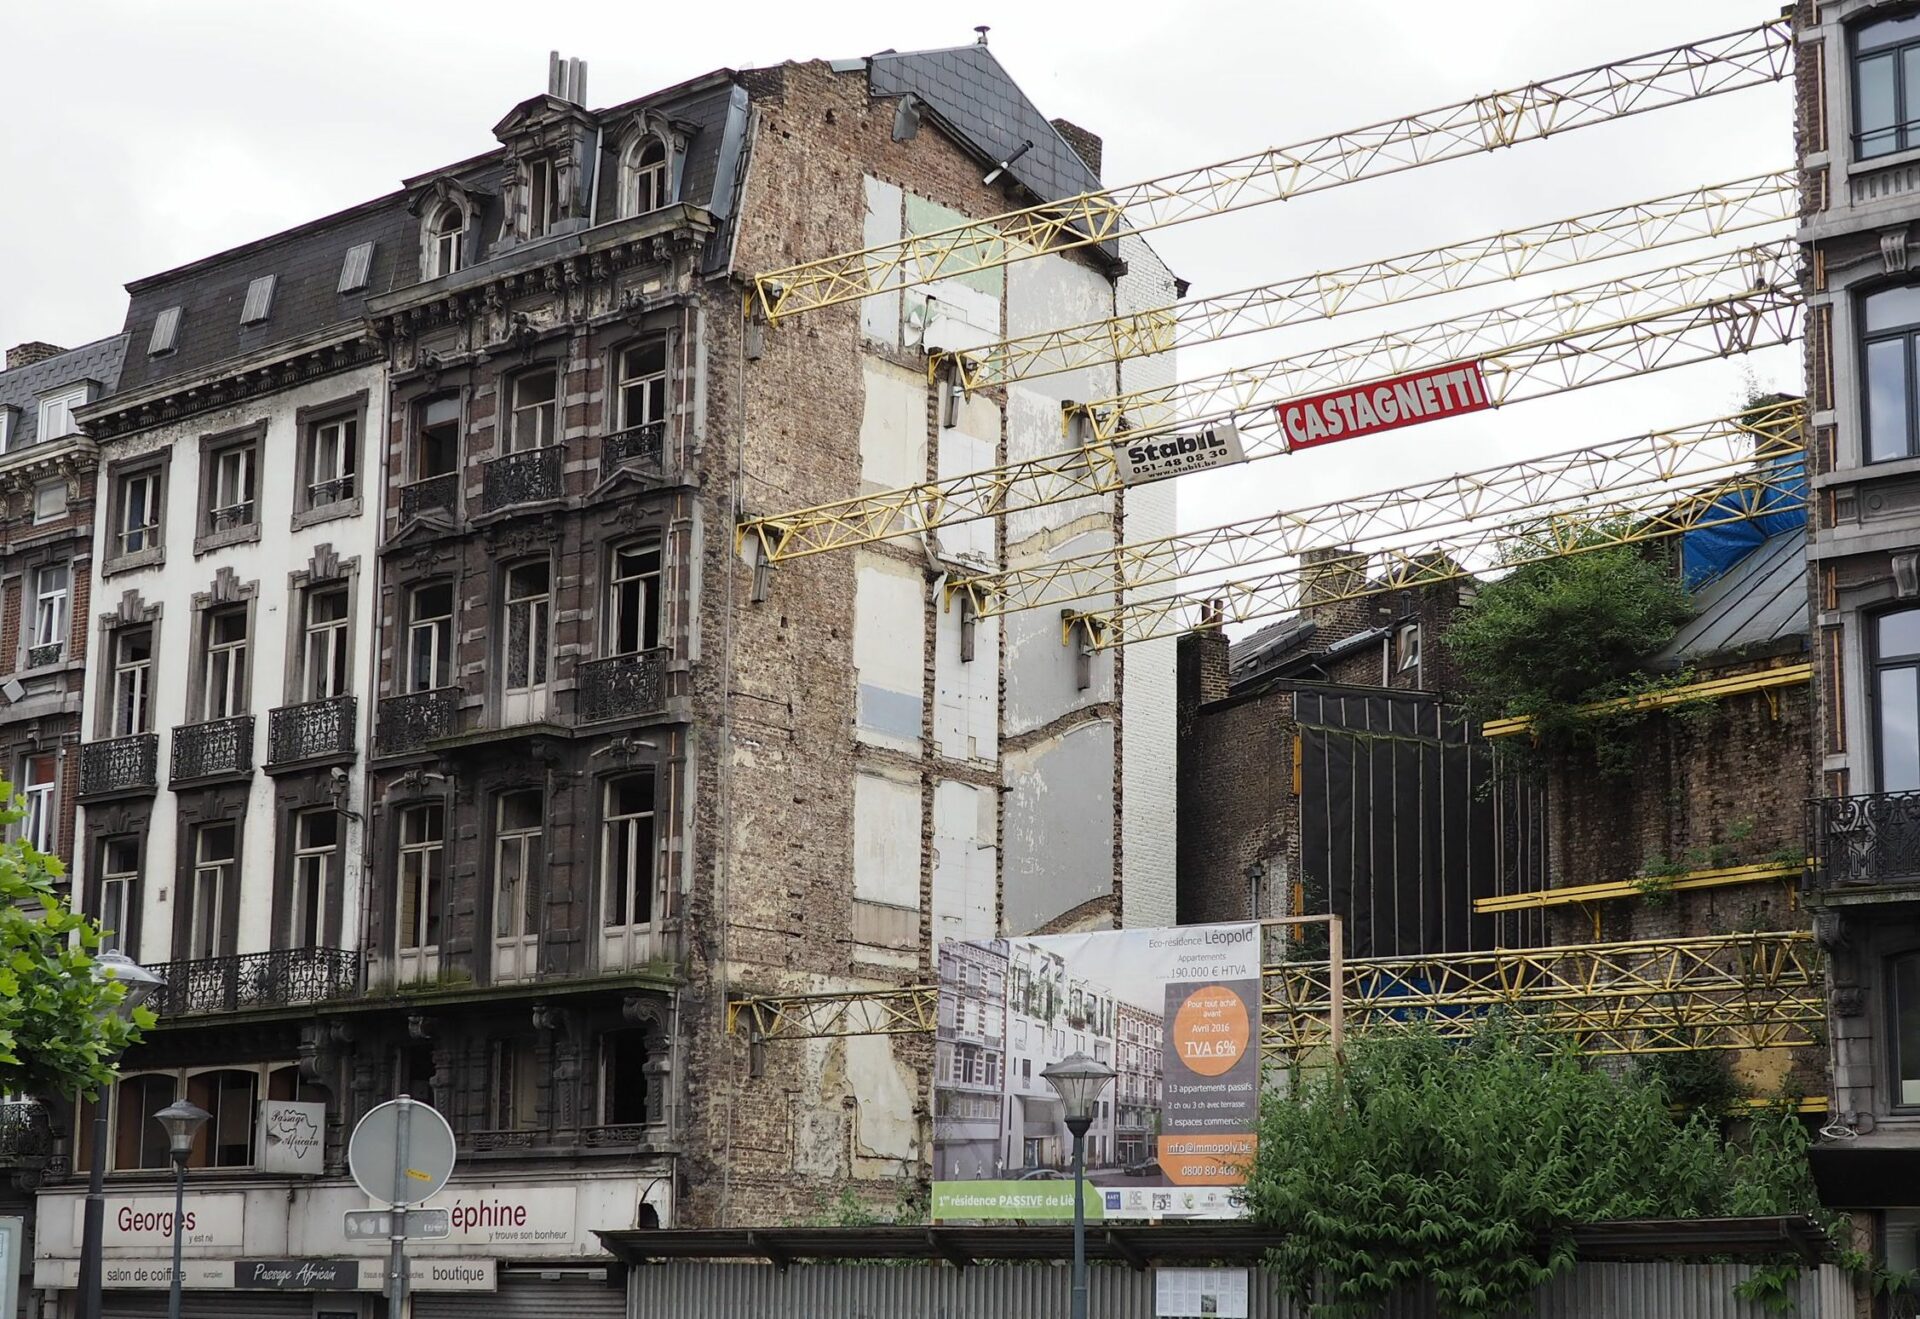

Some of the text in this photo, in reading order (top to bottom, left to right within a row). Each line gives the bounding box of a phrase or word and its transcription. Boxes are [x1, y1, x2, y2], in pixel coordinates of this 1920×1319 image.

[1286, 367, 1484, 442] CASTAGNETTI
[1133, 448, 1228, 474] 051-48 08 30
[1147, 460, 1217, 478] www.stabil.be
[1149, 928, 1253, 949] Eco-résidence Léopold
[1178, 953, 1227, 962] Appartements
[1171, 966, 1209, 978] 190.000
[1211, 966, 1219, 977] €
[1221, 964, 1247, 975] HTVA
[1187, 999, 1237, 1009] Pour tout achat
[1202, 1010, 1222, 1018] avant
[1191, 1023, 1230, 1033] Avril 2016
[1184, 1040, 1237, 1056] TVA 6%
[1168, 1082, 1253, 1095] 13 appartements passifs
[1168, 1102, 1173, 1110] 2
[1173, 1101, 1182, 1110] ch
[1192, 1101, 1198, 1109] 3
[1198, 1101, 1206, 1109] ch
[1168, 1118, 1174, 1127] 3
[1174, 1118, 1203, 1128] espaces
[281, 1134, 319, 1149] Africain
[1166, 1141, 1253, 1154] info@immopoly.be
[1181, 1165, 1203, 1176] 0800
[1204, 1165, 1217, 1176] 80
[951, 1194, 996, 1206] résidence
[999, 1194, 1042, 1206] PASSIVE
[1045, 1194, 1059, 1206] de
[1060, 1193, 1080, 1206] Liè
[188, 1233, 213, 1244] y est né
[488, 1230, 567, 1242] y trouve son bonheur
[107, 1267, 187, 1281] salon de coiffe
[254, 1262, 336, 1287] Passage Africain
[433, 1266, 485, 1284] boutique
